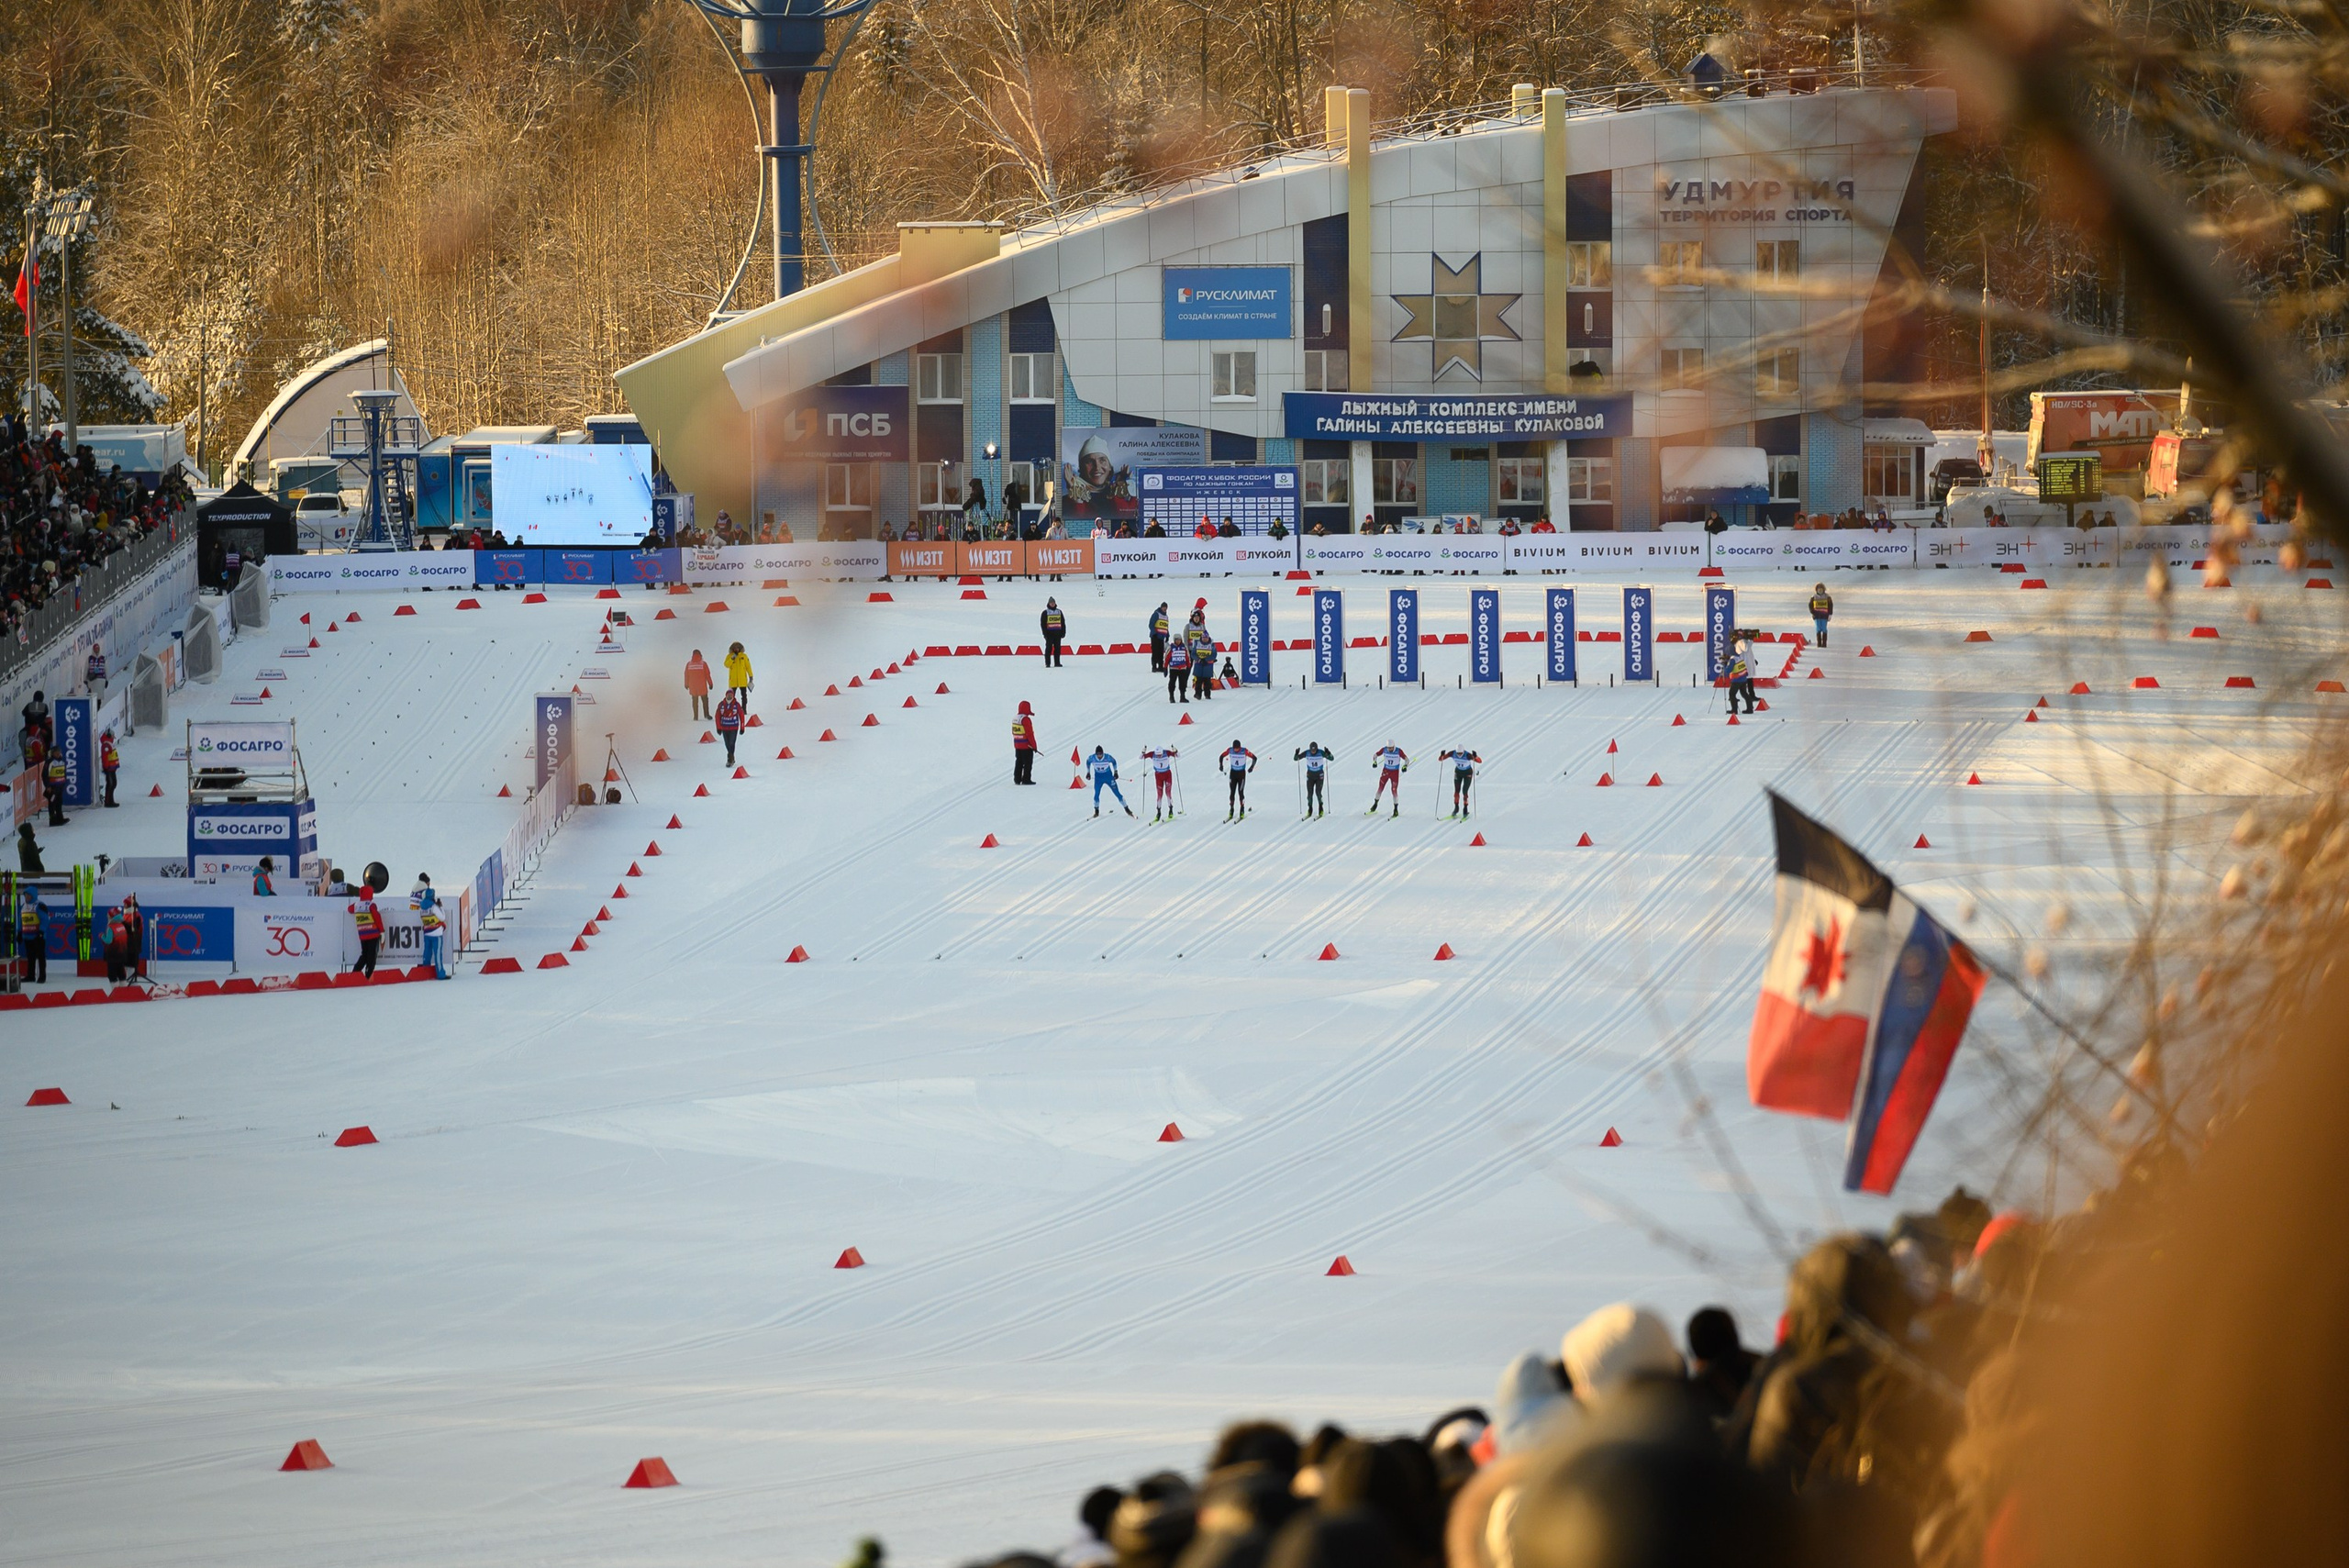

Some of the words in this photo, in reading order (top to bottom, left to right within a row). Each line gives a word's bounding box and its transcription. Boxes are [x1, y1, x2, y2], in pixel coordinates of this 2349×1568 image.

[1663, 179, 1854, 204] УДМУРТИЯ
[1660, 209, 1776, 223] ТЕРРИТОРИЯ
[1785, 208, 1854, 221] СПОРТА
[1196, 290, 1277, 301] РУСКЛИМАТ
[1341, 399, 1418, 416] ЛЫЖНЫЙ
[1429, 402, 1518, 416] КОМПЛЕКС
[1522, 400, 1577, 415] ИМЕНИ
[827, 413, 891, 437] ПСБ
[1316, 417, 1380, 433] ГАЛИНЫ
[1390, 419, 1504, 434] АЛЕКСЕЕВНЫ
[1514, 414, 1604, 432] КУЛАКОВОЙ
[1247, 550, 1291, 559] ЛУКОЙЛ
[1318, 550, 1364, 559] ФОСАГРО
[1386, 550, 1431, 559] ФОСАГРО
[1453, 550, 1498, 559] ФОСАГРО
[1514, 548, 1565, 557] BIVIUM
[1581, 547, 1632, 556] BIVIUM
[1648, 546, 1699, 555] BIVIUM
[1728, 547, 1774, 555] ФОСАГРО
[1863, 545, 1908, 553] ФОСАГРО
[833, 558, 879, 566] ФОСАГРО
[916, 551, 943, 565] ИЗТТ
[985, 550, 1012, 565] ИЗТТ
[1054, 550, 1083, 564] ИЗТТ
[1112, 552, 1156, 562] ЛУКОЙЛ
[1180, 551, 1224, 561] ЛУКОЙЛ
[420, 566, 467, 574] ФОСАГРО
[632, 561, 662, 580] 30
[766, 560, 812, 569] ФОСАГРО
[285, 571, 331, 579] ФОСАГРО
[353, 569, 399, 577] ФОСАГРО
[494, 562, 523, 580] 30
[563, 562, 593, 580] 30
[1249, 614, 1258, 674] ФОСАГРО
[1321, 614, 1331, 674] ФОСАГРО
[1397, 613, 1408, 674] ФОСАГРО
[1478, 613, 1488, 674] ФОСАГРО
[1553, 612, 1564, 673] ФОСАГРО
[1631, 611, 1642, 673] ФОСАГРО
[217, 740, 284, 751] ФОСАГРО
[66, 726, 77, 795] ФОСАГРО
[217, 824, 284, 834] ФОСАГРО
[203, 863, 217, 873] 30
[158, 925, 202, 955] 30
[266, 928, 310, 957] 30
